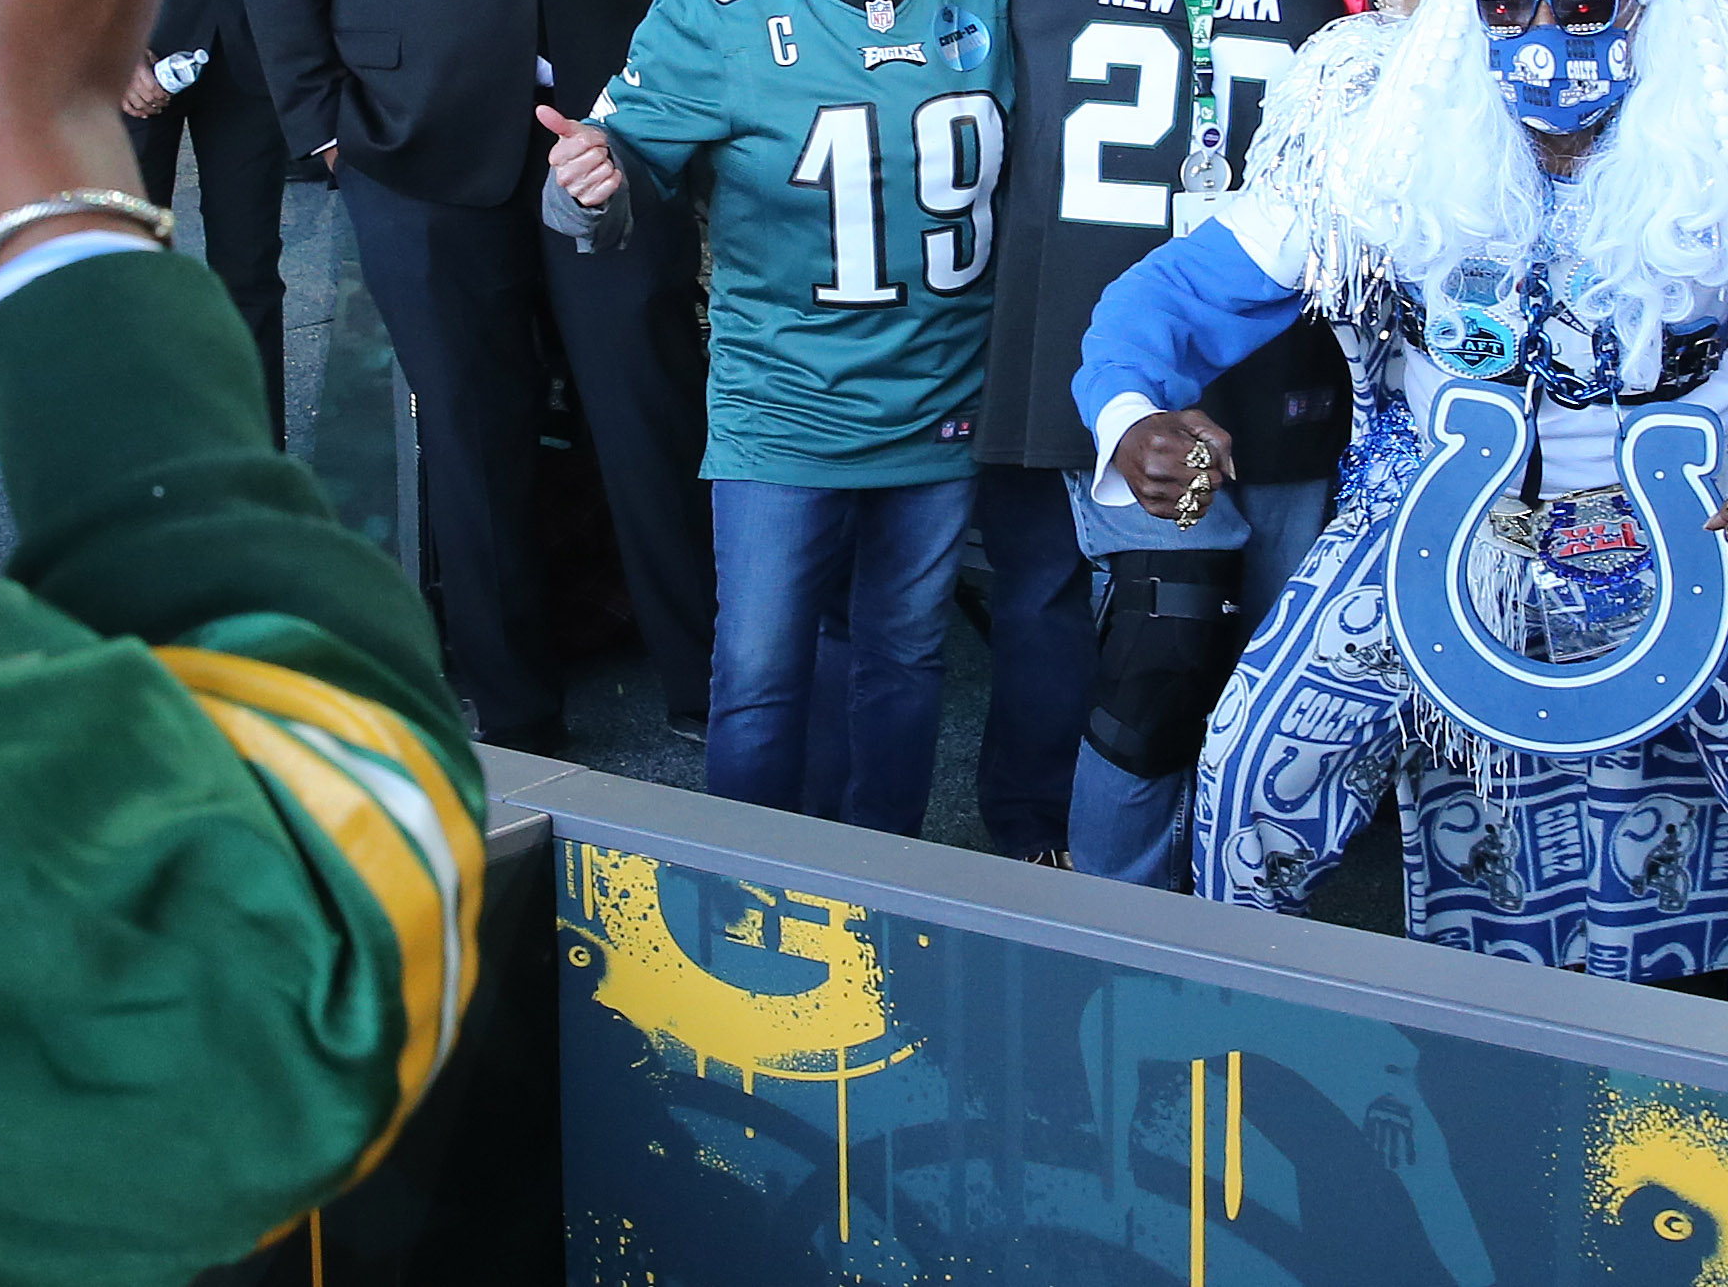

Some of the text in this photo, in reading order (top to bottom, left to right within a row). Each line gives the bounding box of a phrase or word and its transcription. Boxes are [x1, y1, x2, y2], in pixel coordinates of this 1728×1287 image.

[768, 16, 798, 66] C
[862, 43, 927, 68] EAGLES
[788, 89, 1010, 310] 19
